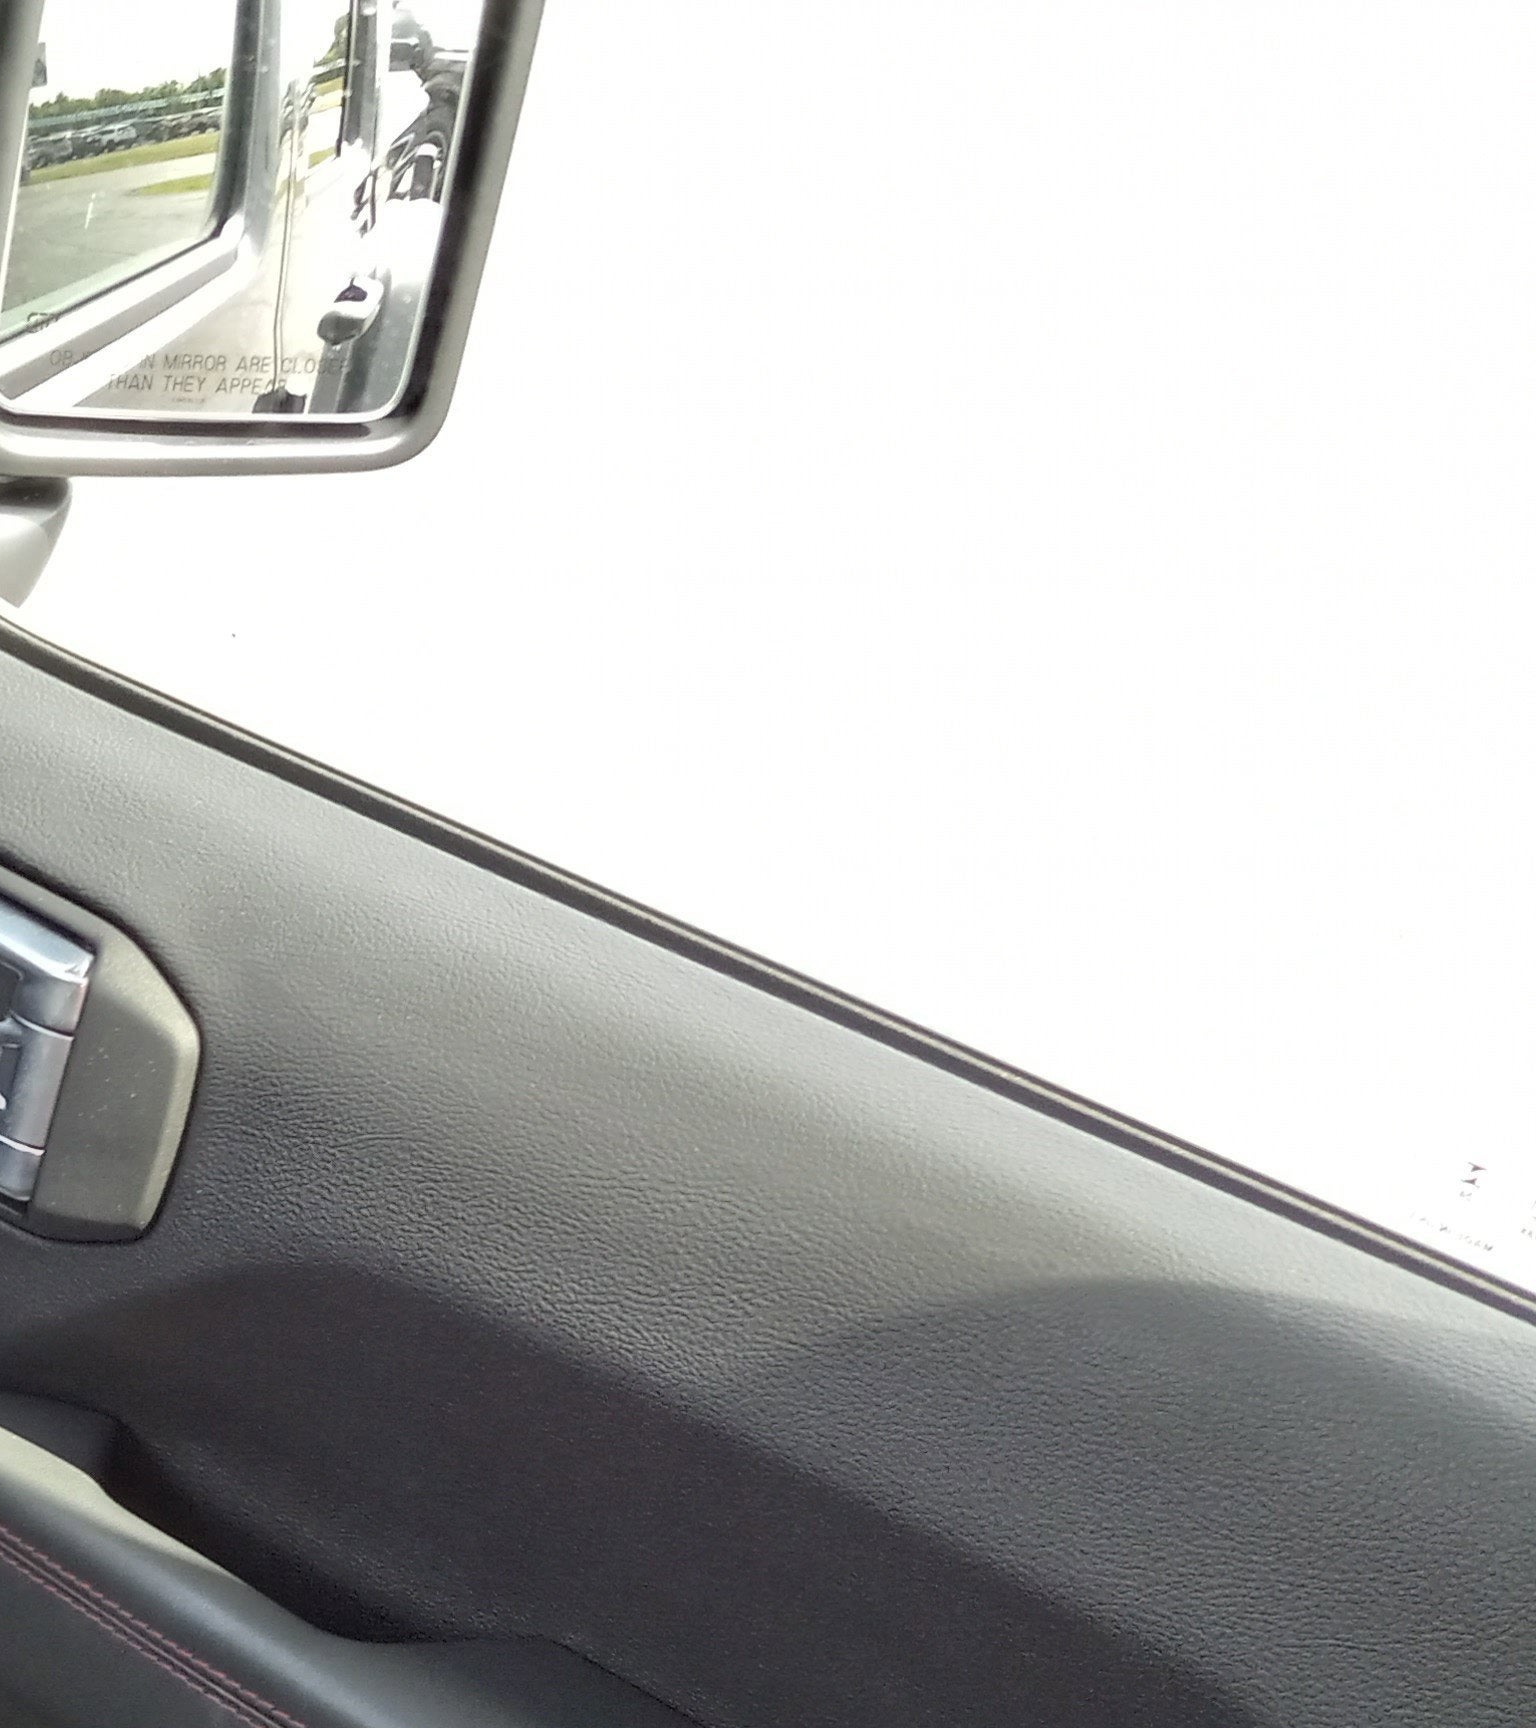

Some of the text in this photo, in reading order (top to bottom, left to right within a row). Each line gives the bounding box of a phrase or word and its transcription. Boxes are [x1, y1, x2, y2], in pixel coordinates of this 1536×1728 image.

[162, 355, 227, 372] MIRROR
[235, 356, 273, 372] ARE
[163, 375, 207, 393] THEY
